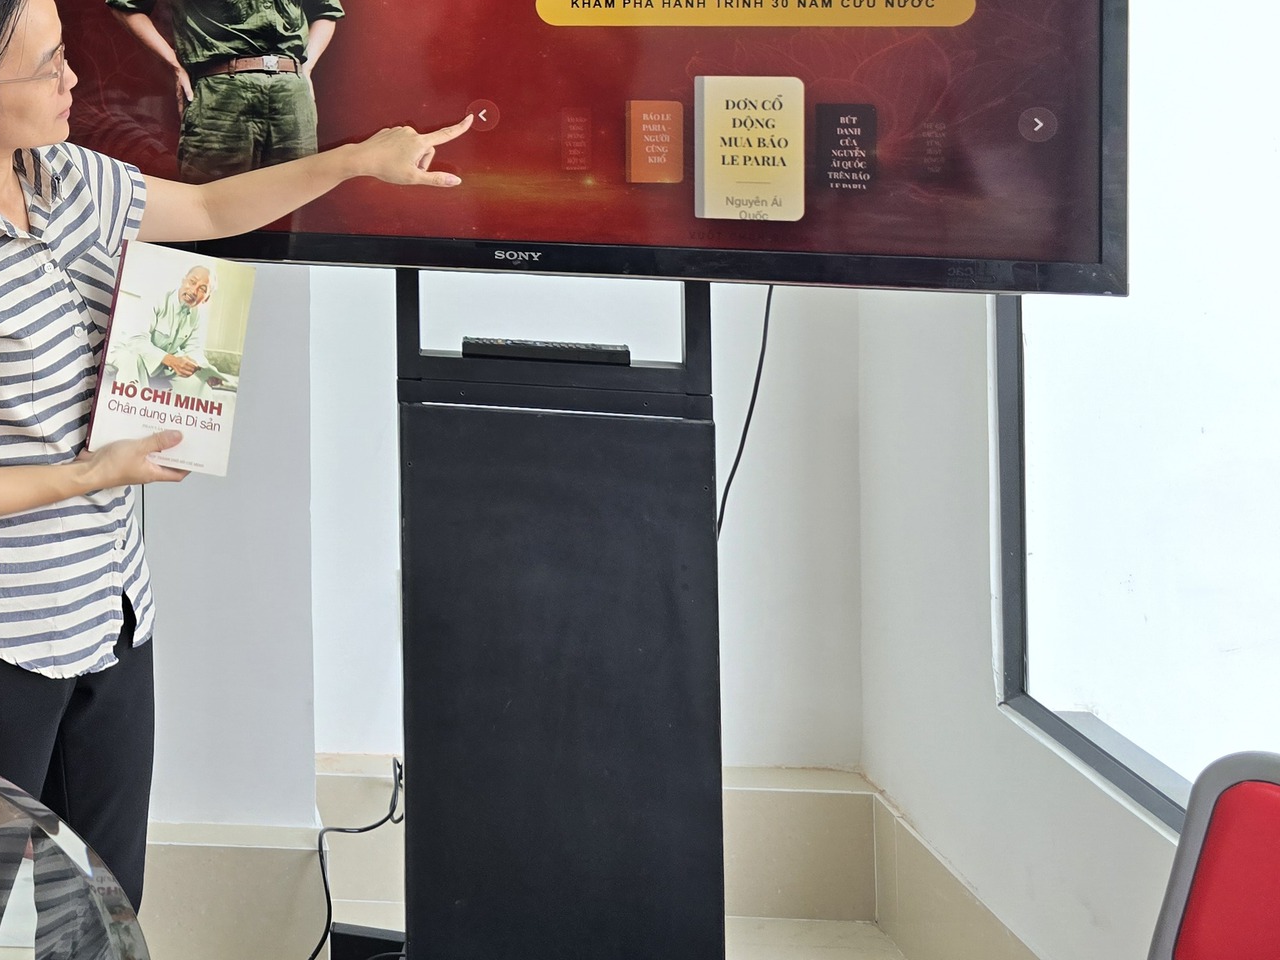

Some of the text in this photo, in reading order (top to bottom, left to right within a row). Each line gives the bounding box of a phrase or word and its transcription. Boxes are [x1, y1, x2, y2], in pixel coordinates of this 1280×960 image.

[721, 135, 788, 148] MUA BÁO
[722, 155, 786, 166] LE PARIA
[495, 251, 541, 263] SONY
[111, 380, 222, 416] HỒ CHÍ MINH
[108, 399, 220, 431] Chân dung và Di sản
